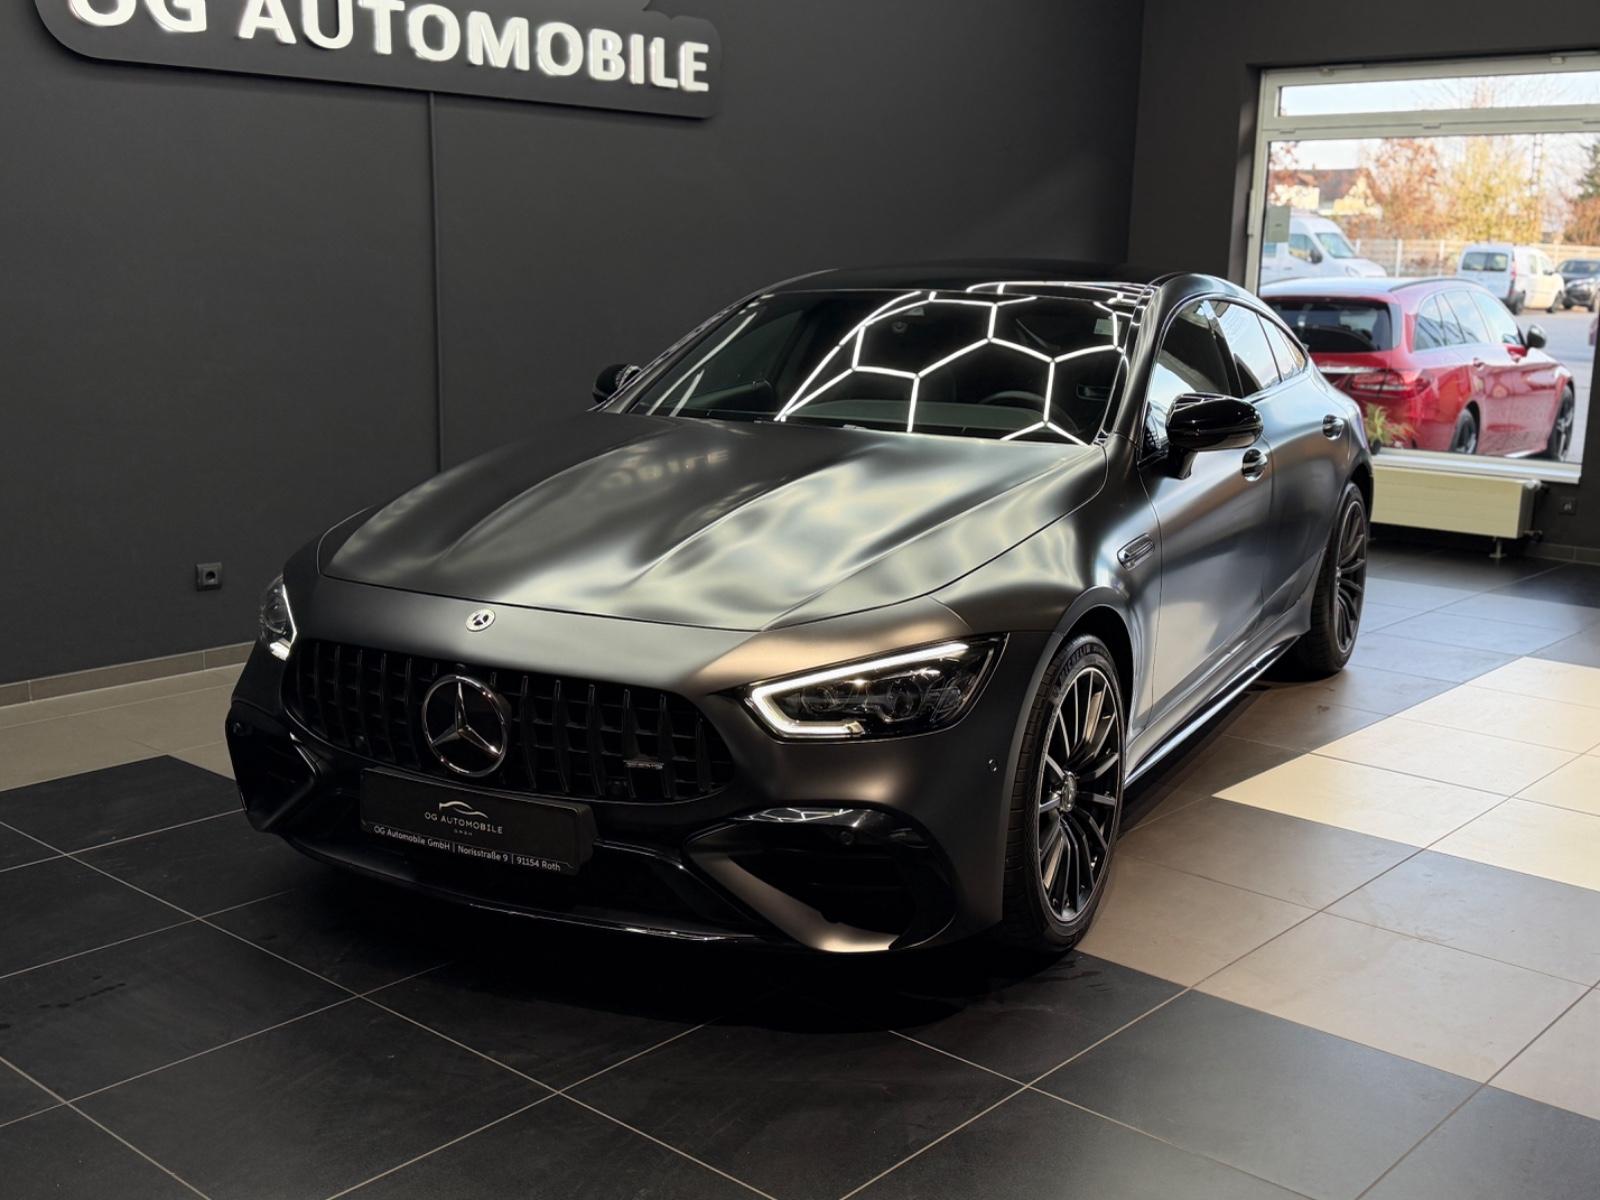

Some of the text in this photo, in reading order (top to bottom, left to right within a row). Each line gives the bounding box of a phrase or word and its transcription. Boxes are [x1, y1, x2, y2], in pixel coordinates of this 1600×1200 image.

[239, 0, 710, 92] AUTOMOBILE
[424, 811, 438, 822] OG
[440, 815, 503, 834] AUTOMOBILE
[373, 825, 386, 836] OG
[386, 828, 425, 846] Automobile
[427, 838, 450, 851] GmbH
[457, 845, 502, 861] Norisstraße
[502, 854, 509, 862] 9
[516, 856, 540, 868] 91154
[541, 858, 561, 872] Roth
